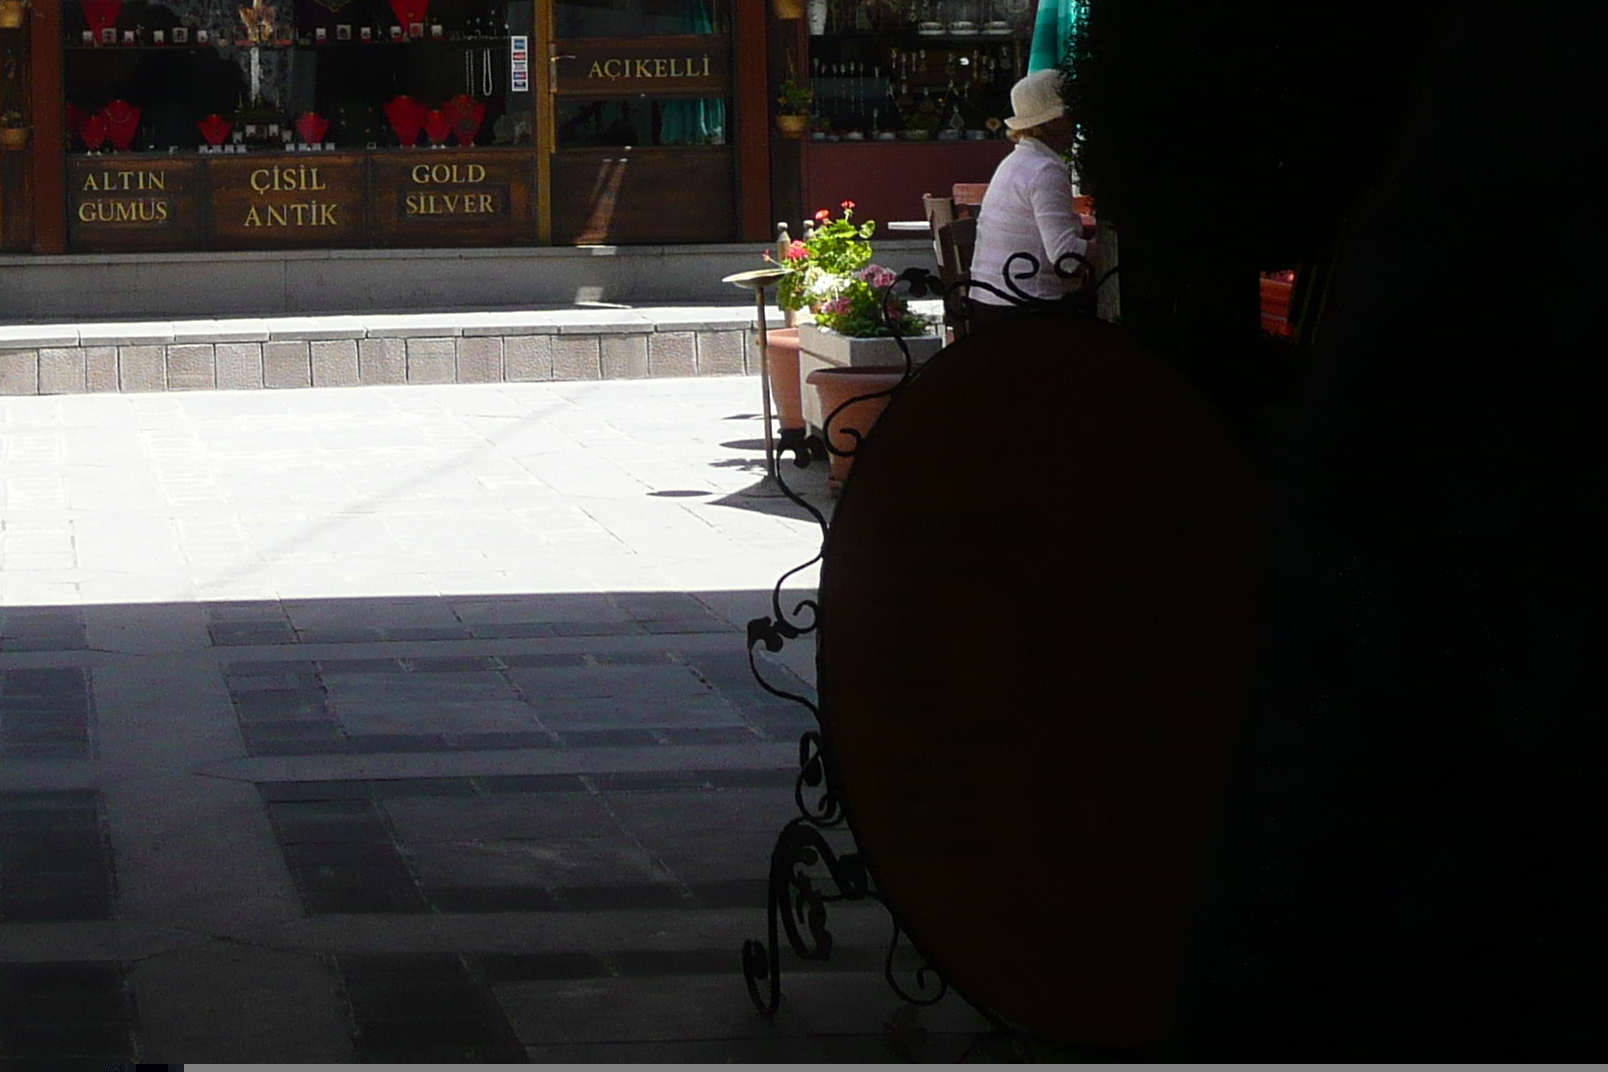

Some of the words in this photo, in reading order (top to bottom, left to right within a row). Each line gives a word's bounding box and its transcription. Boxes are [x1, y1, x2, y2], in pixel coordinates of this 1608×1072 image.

[587, 53, 712, 81] AÇIKELLİ
[82, 171, 166, 192] ALTIN
[249, 164, 327, 195] ÇİSİL
[411, 164, 487, 184] GOLD
[243, 199, 339, 227] ANTİK
